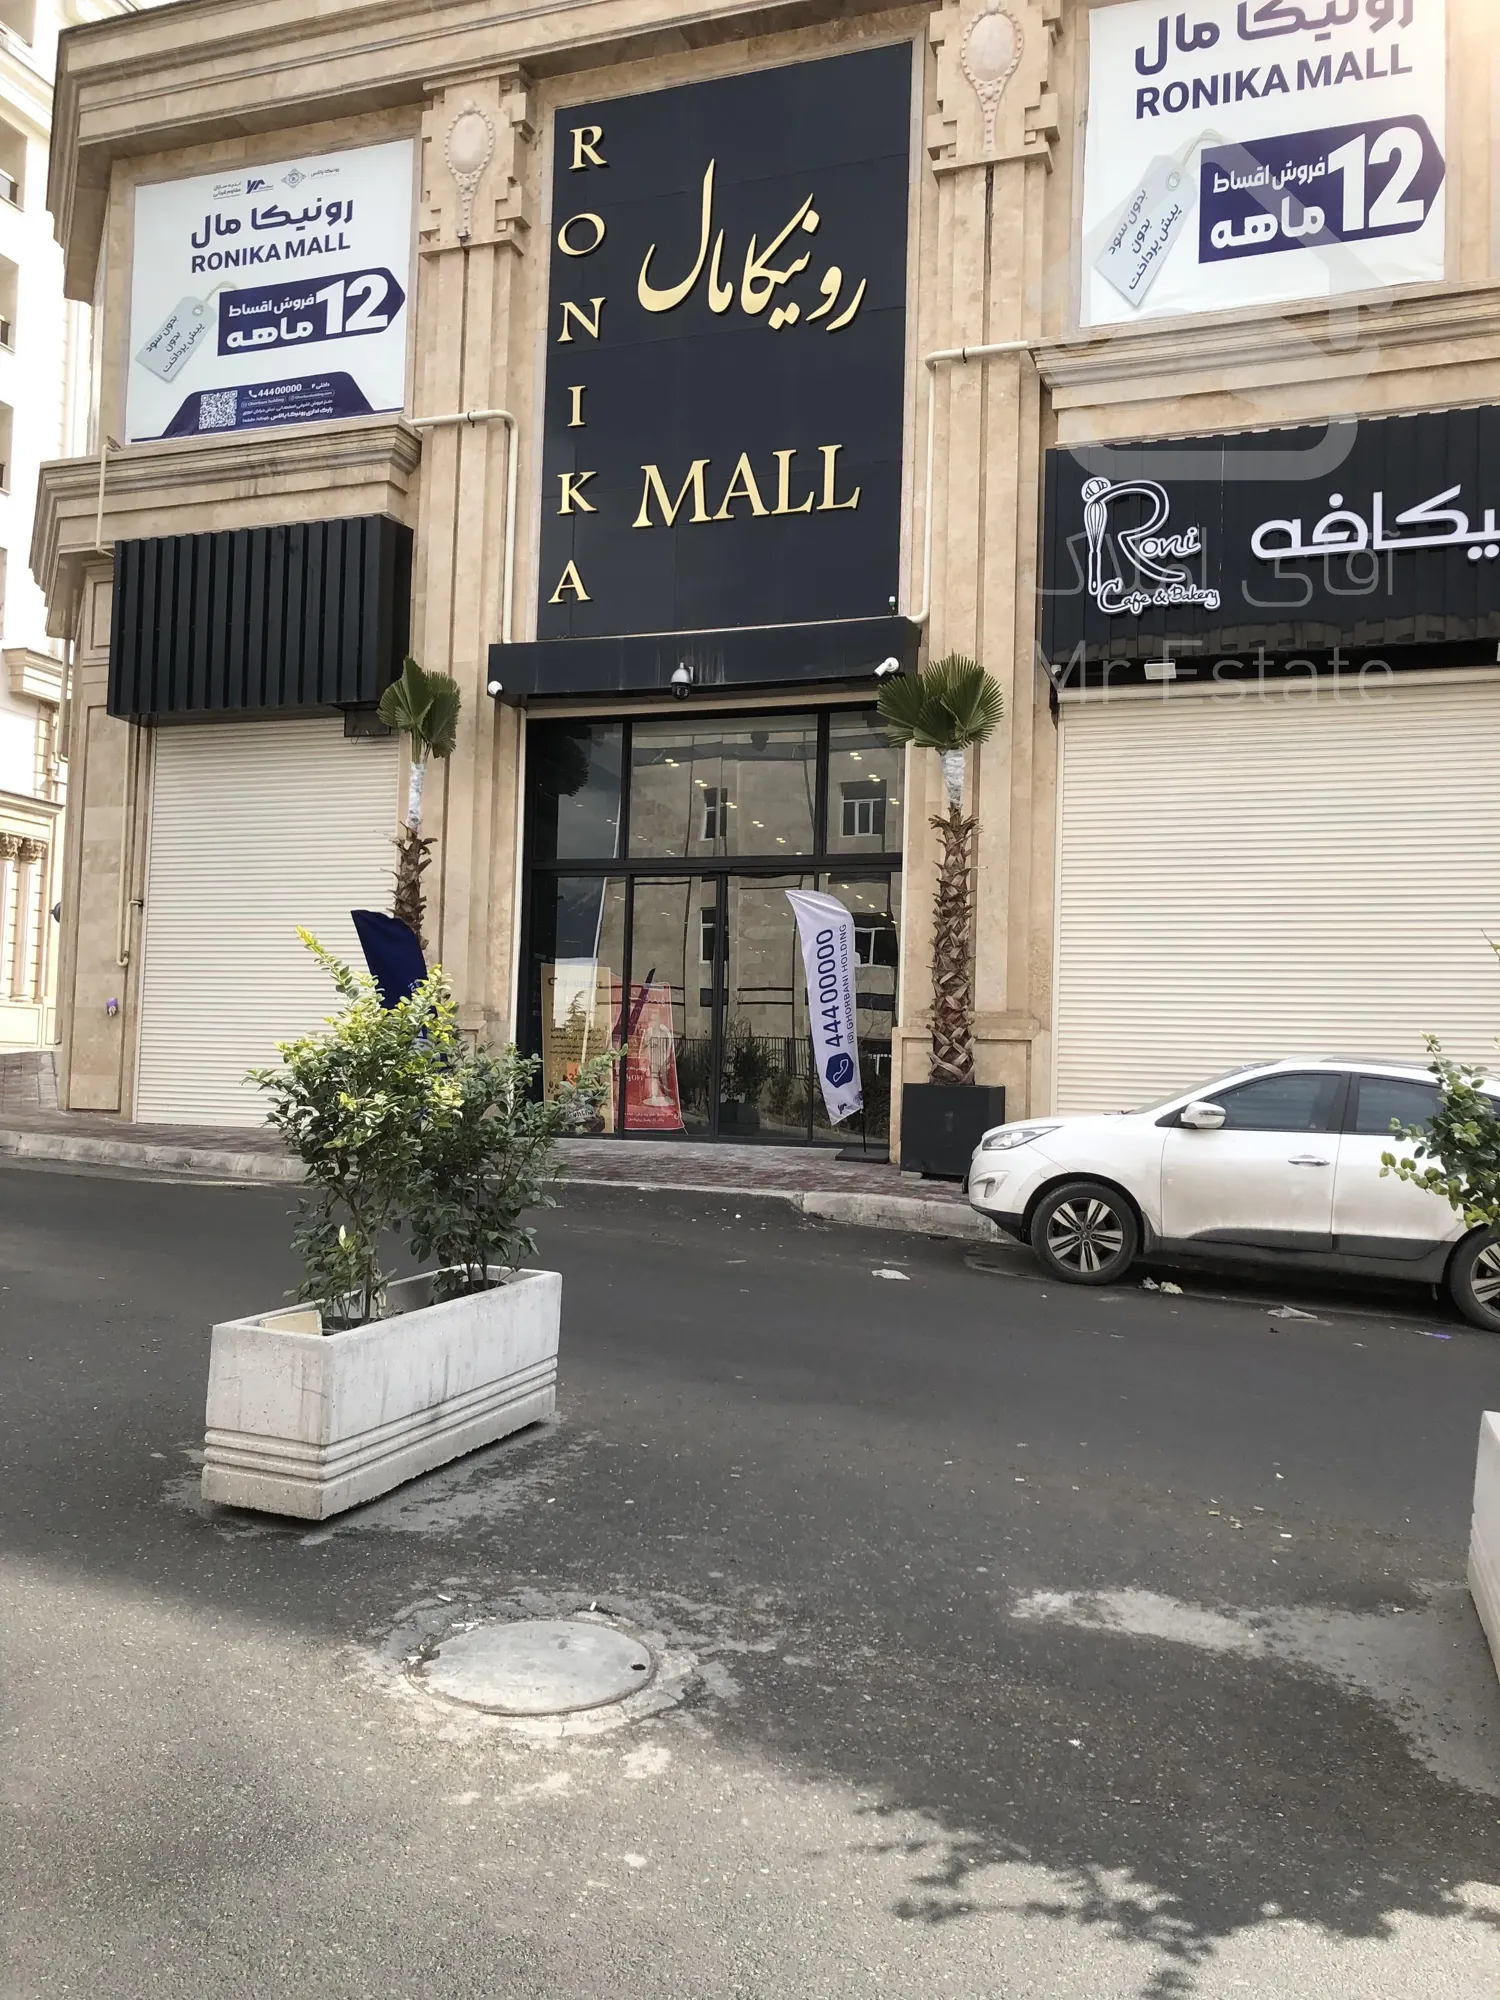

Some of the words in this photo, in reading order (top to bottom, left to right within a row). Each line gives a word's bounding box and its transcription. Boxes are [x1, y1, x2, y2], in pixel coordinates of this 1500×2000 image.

[1135, 13, 1221, 76] مال
[1136, 63, 1290, 120] RONIKA
[1297, 43, 1413, 90] MALL
[1213, 164, 1270, 193] اقساط
[1272, 157, 1326, 191] فروش
[1328, 126, 1424, 232] 12
[251, 197, 353, 231] رونیکا
[1128, 189, 1148, 225] بدون
[1159, 204, 1182, 242] پیش
[1210, 196, 1325, 249] ماهه
[191, 213, 241, 249] مال
[1108, 223, 1128, 255] سود
[1131, 219, 1152, 254] بدون
[192, 243, 281, 274] RONIKA
[285, 232, 351, 260] MALL
[1129, 240, 1162, 290] پرداخت
[228, 300, 272, 317] اقساط
[273, 294, 315, 314] فروش
[316, 274, 389, 335] 12
[146, 334, 163, 352] سود
[162, 315, 179, 336] بدون
[165, 332, 182, 352] بدون
[187, 323, 205, 345] پیش
[226, 317, 314, 348] ماهه
[163, 343, 190, 372] پرداخت
[258, 383, 302, 397] 44400000
[632, 444, 861, 529] MALL
[1082, 477, 1202, 594] Roni
[1250, 483, 1500, 561] یکافه
[1098, 577, 1151, 615] Cafe
[1153, 588, 1169, 606] &
[1169, 583, 1220, 610] Bakery
[816, 929, 844, 1047] 44400000
